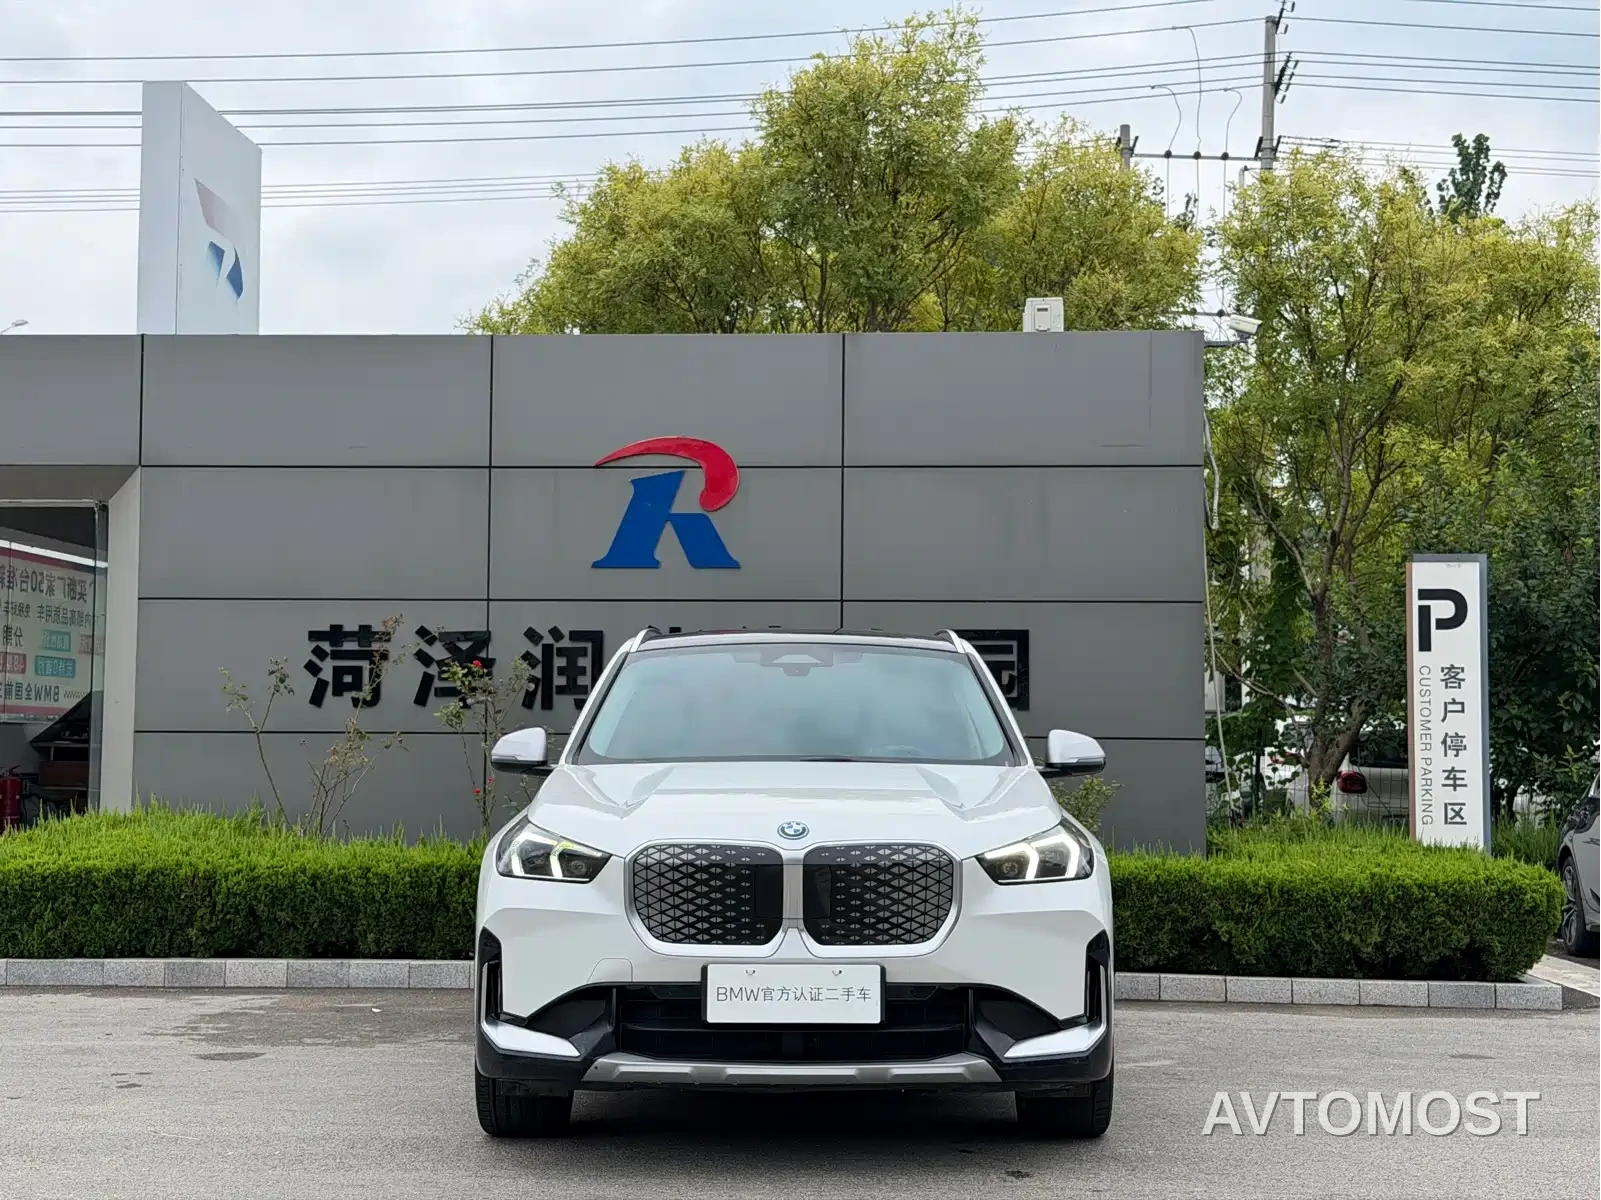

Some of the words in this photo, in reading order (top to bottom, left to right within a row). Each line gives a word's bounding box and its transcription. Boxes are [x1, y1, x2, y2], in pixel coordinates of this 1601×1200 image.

[1417, 588, 1469, 652] P
[1419, 665, 1432, 752] CUSTOMER
[1440, 664, 1468, 826] 客户停车区
[1421, 757, 1434, 826] PARKING
[716, 986, 872, 1003] BMW官方认证二手车
